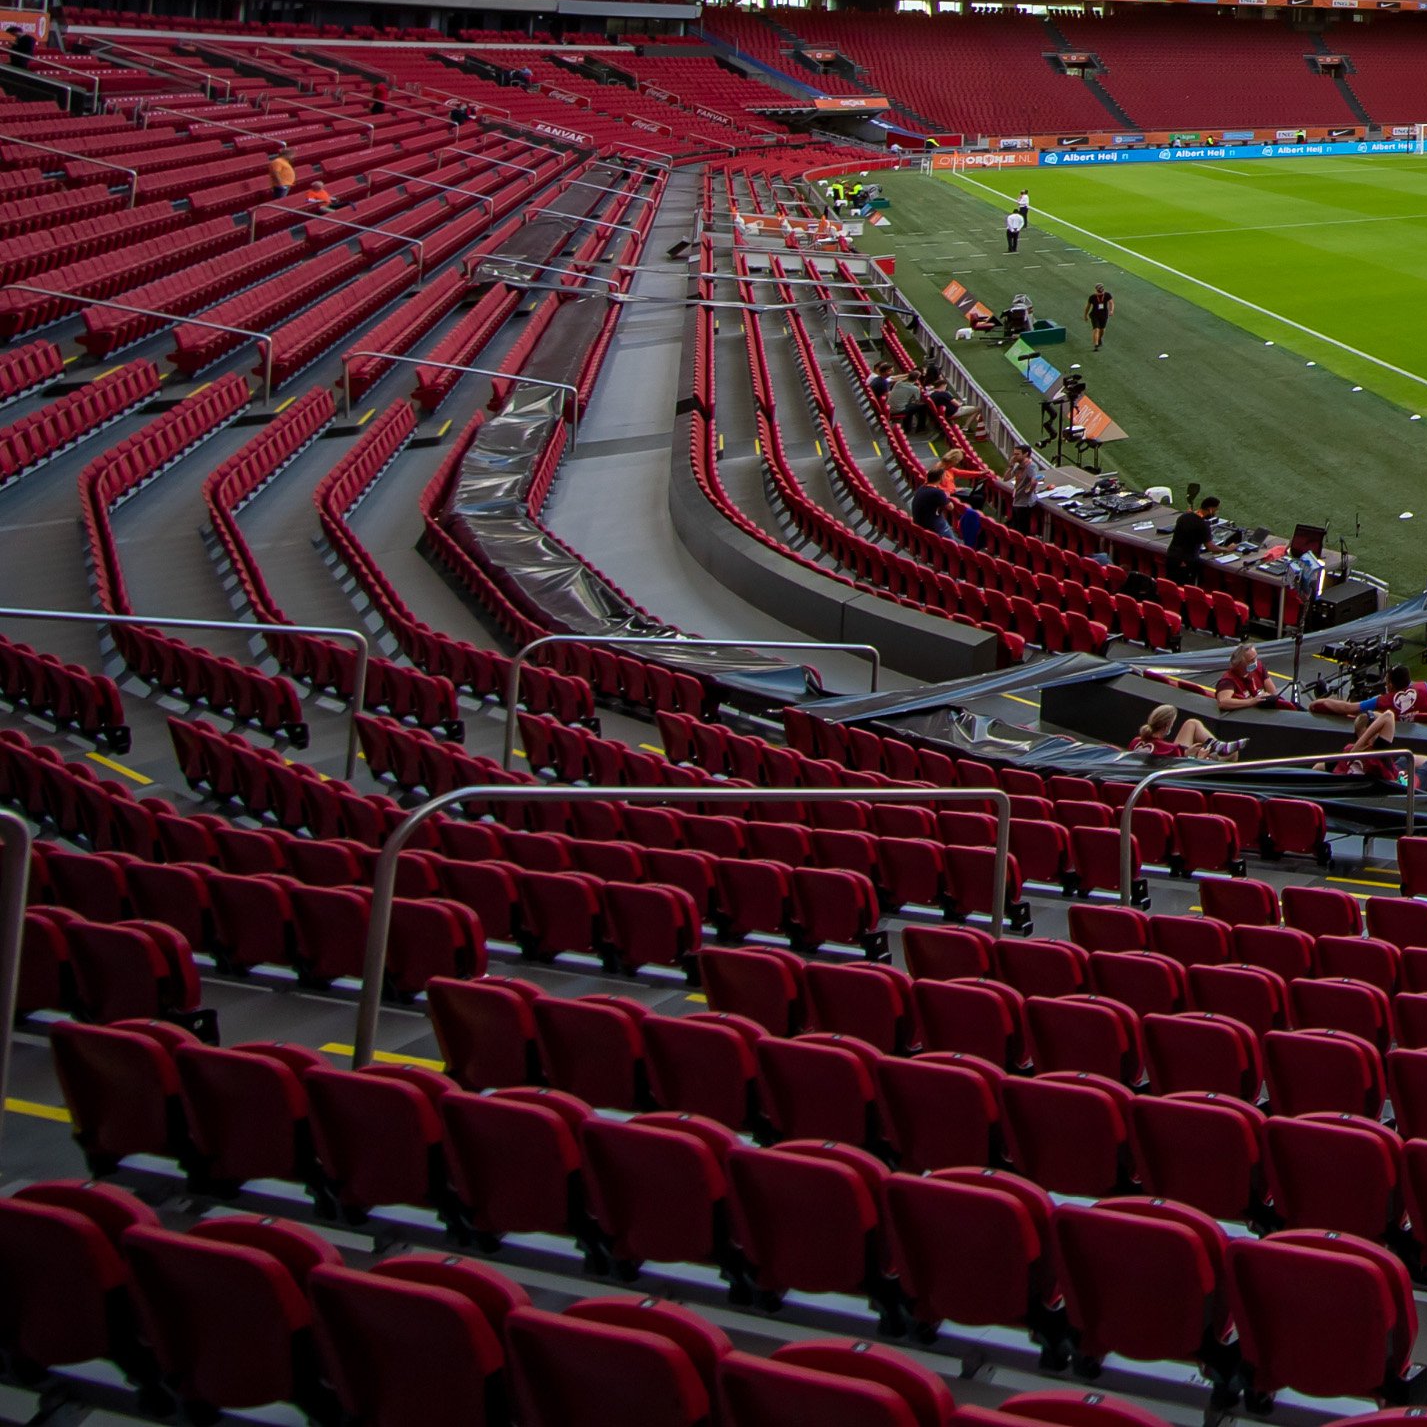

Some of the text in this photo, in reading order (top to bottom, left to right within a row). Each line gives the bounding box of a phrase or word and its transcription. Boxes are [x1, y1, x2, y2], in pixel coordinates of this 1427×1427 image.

[696, 108, 730, 125] FANVAK
[535, 123, 587, 144] FANVAK
[1277, 146, 1304, 154] Albert
[1371, 143, 1397, 151] Albert
[1063, 153, 1095, 162] Albert
[1175, 149, 1205, 158] Albert
